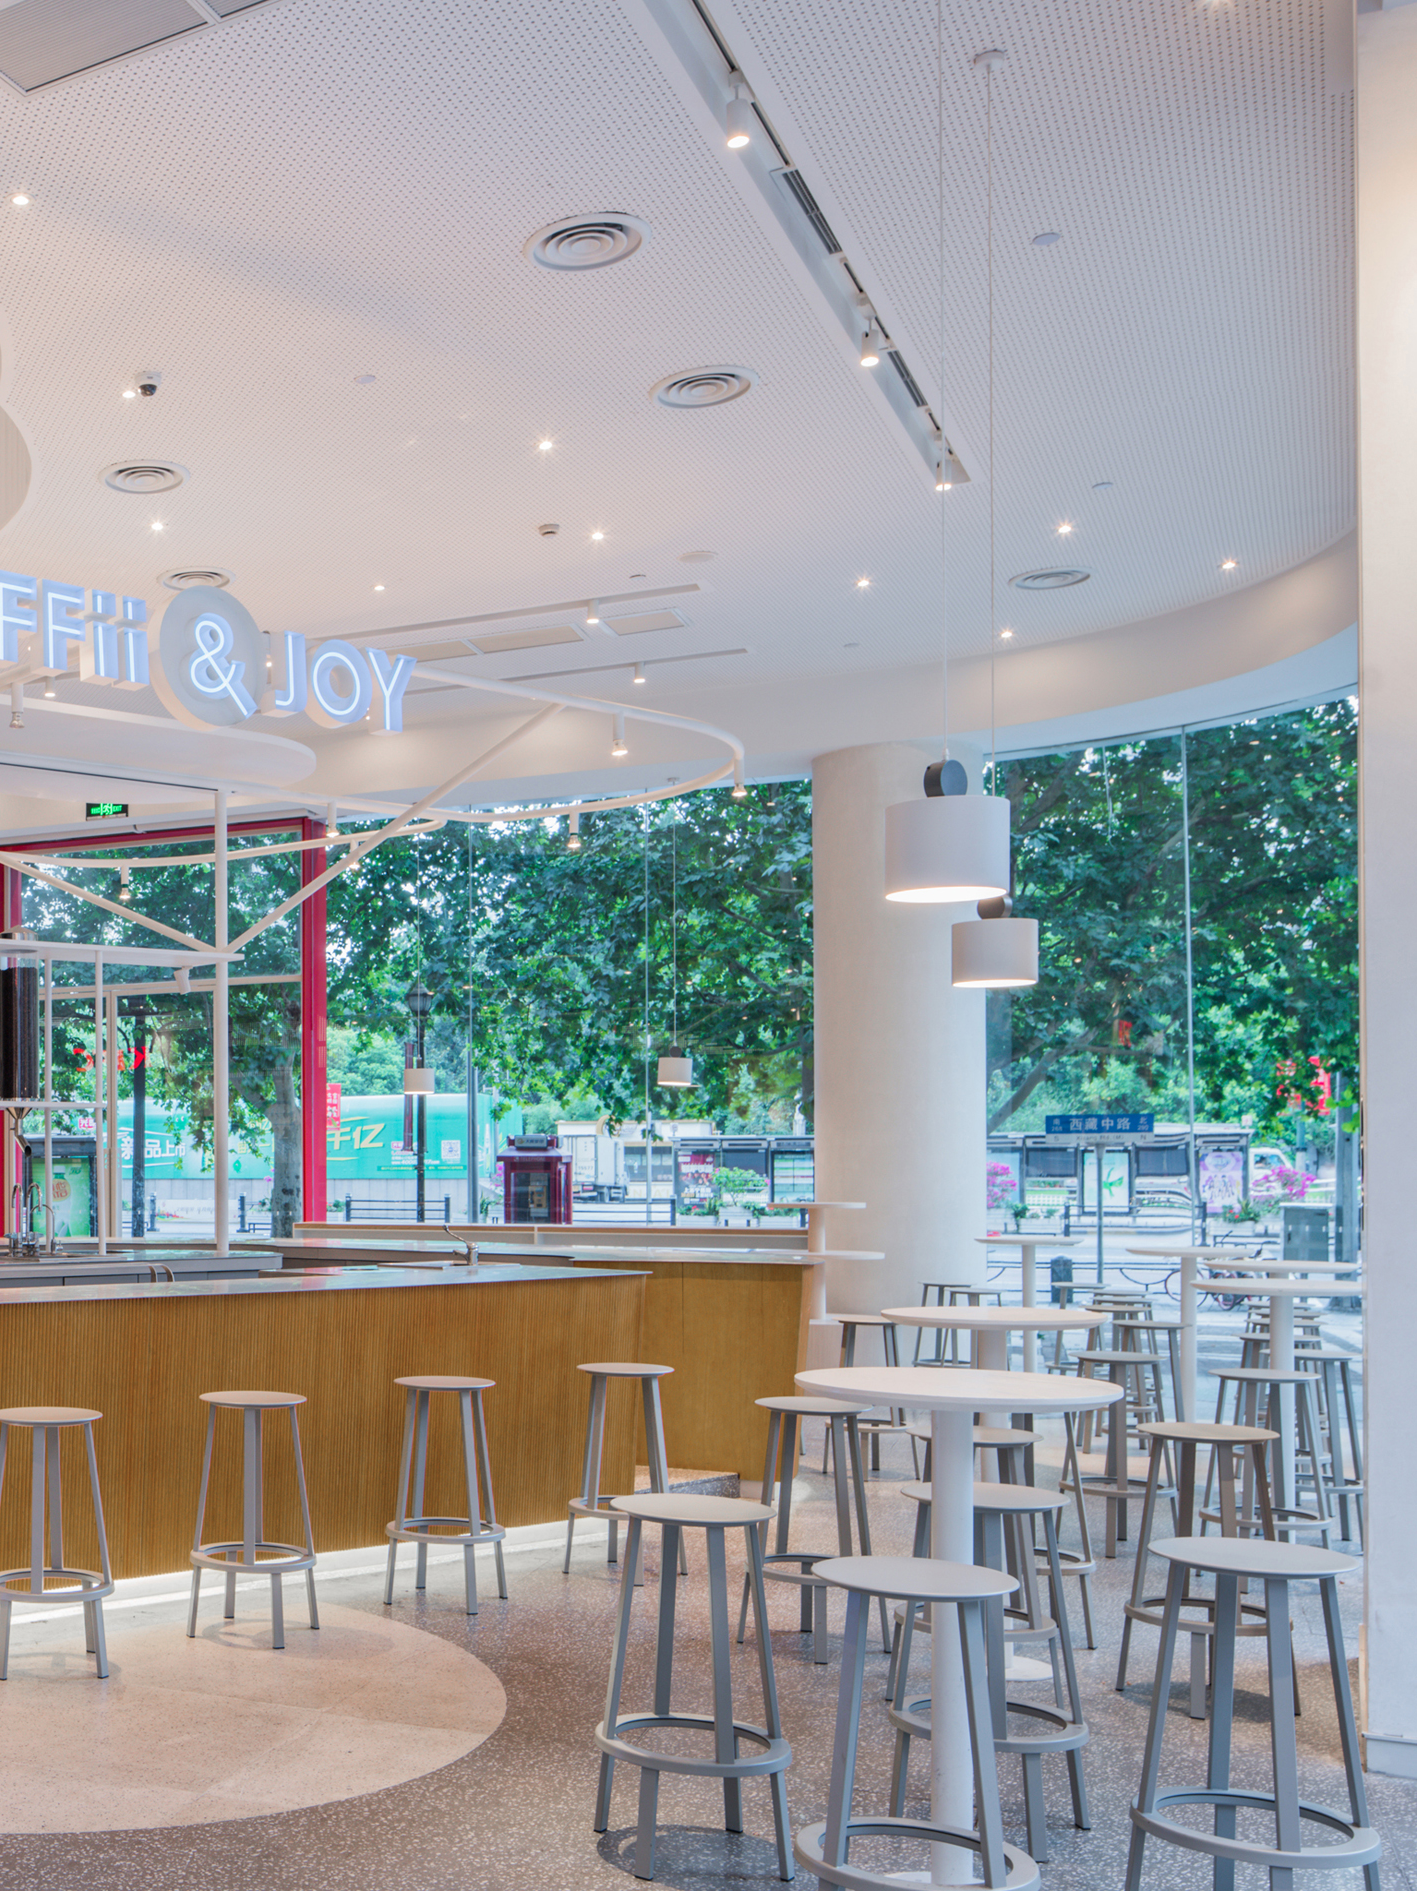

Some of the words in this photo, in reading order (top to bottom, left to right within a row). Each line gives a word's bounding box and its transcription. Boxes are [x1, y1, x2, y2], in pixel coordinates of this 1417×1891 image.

[188, 611, 258, 719] &
[272, 630, 417, 733] JOY
[1069, 1117, 1131, 1131] 西藏中路
